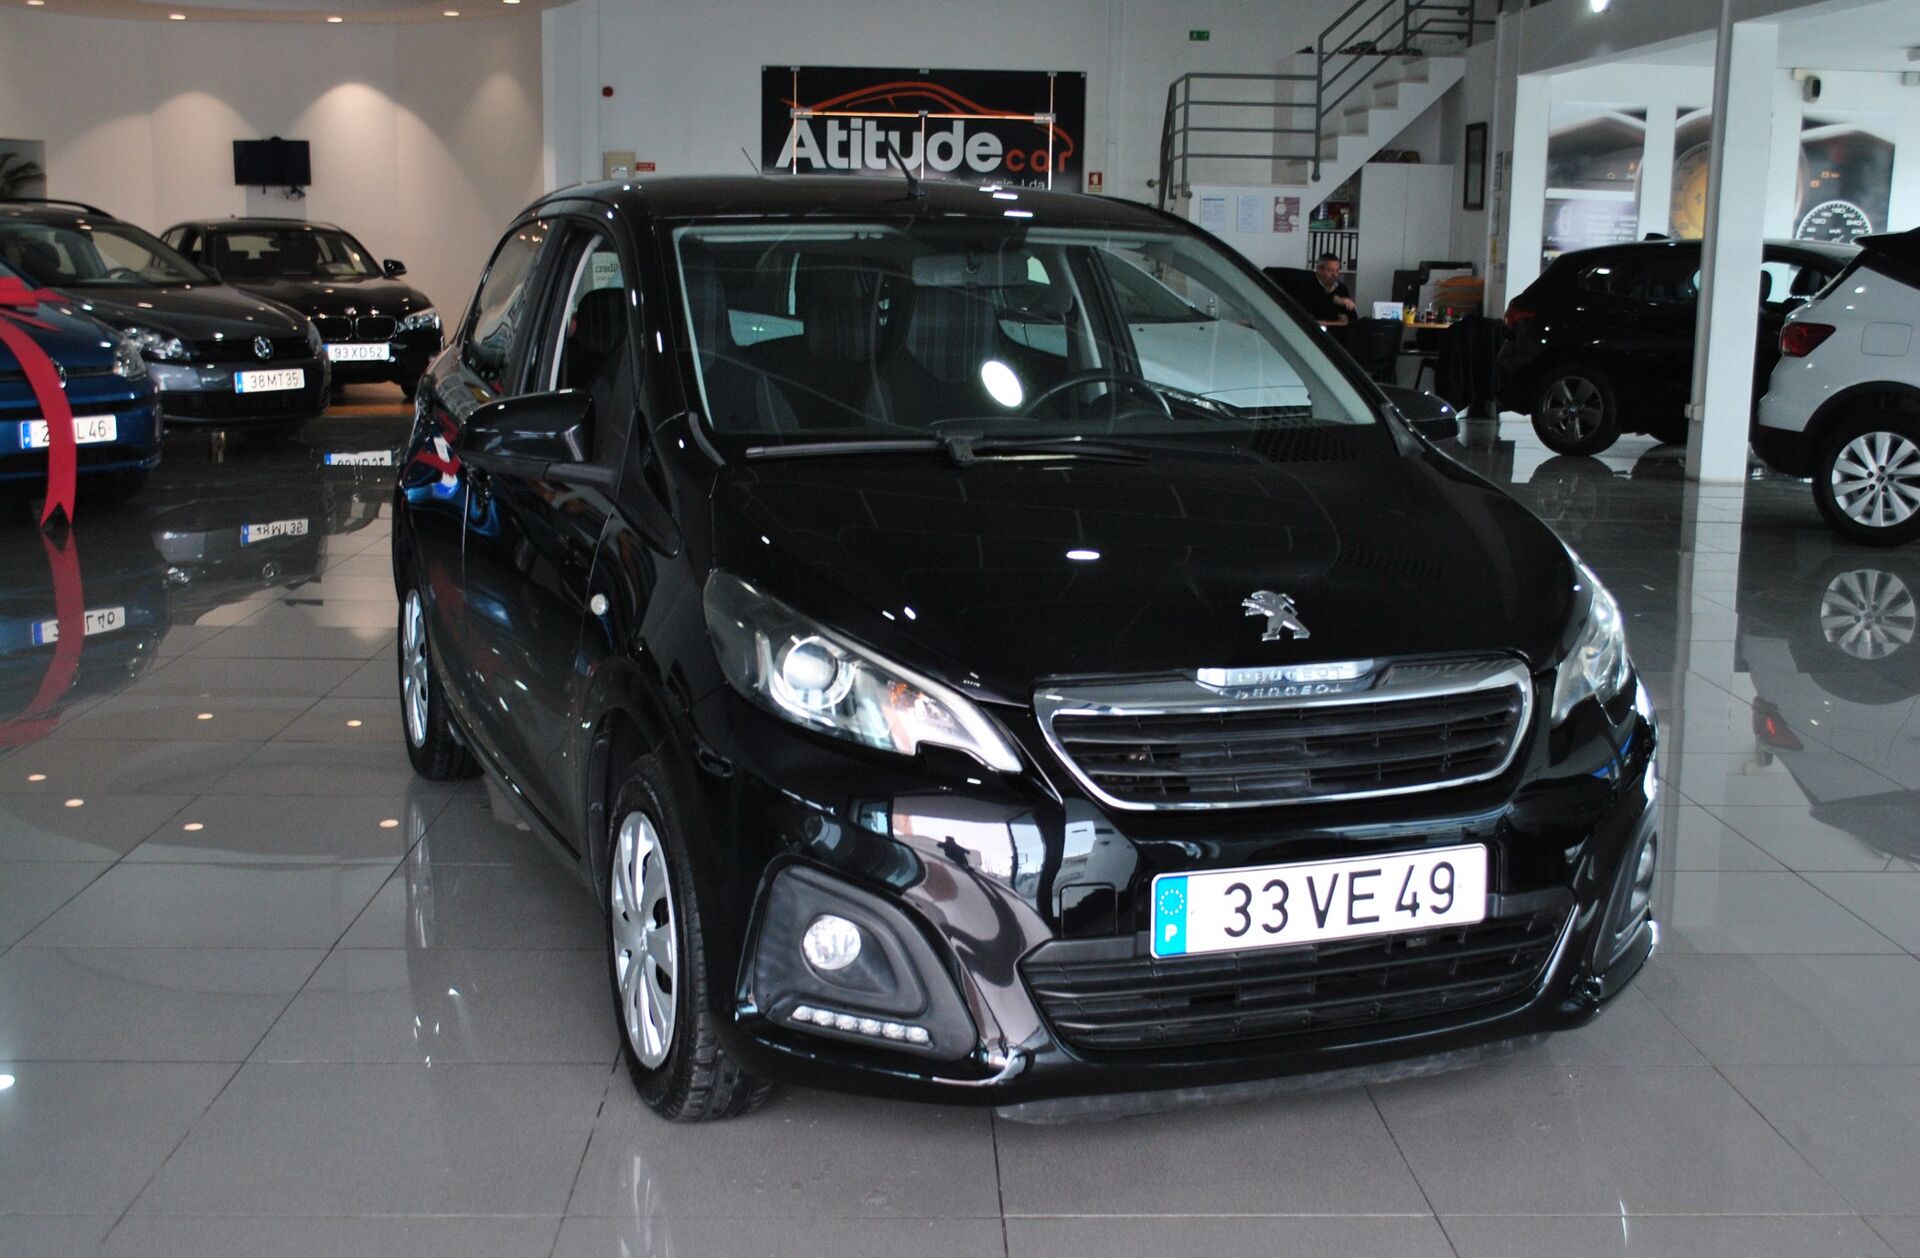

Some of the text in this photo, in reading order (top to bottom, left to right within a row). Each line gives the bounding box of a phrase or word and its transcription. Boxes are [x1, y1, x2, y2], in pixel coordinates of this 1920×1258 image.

[776, 118, 1073, 173] Atitude car
[1164, 923, 1178, 942] P
